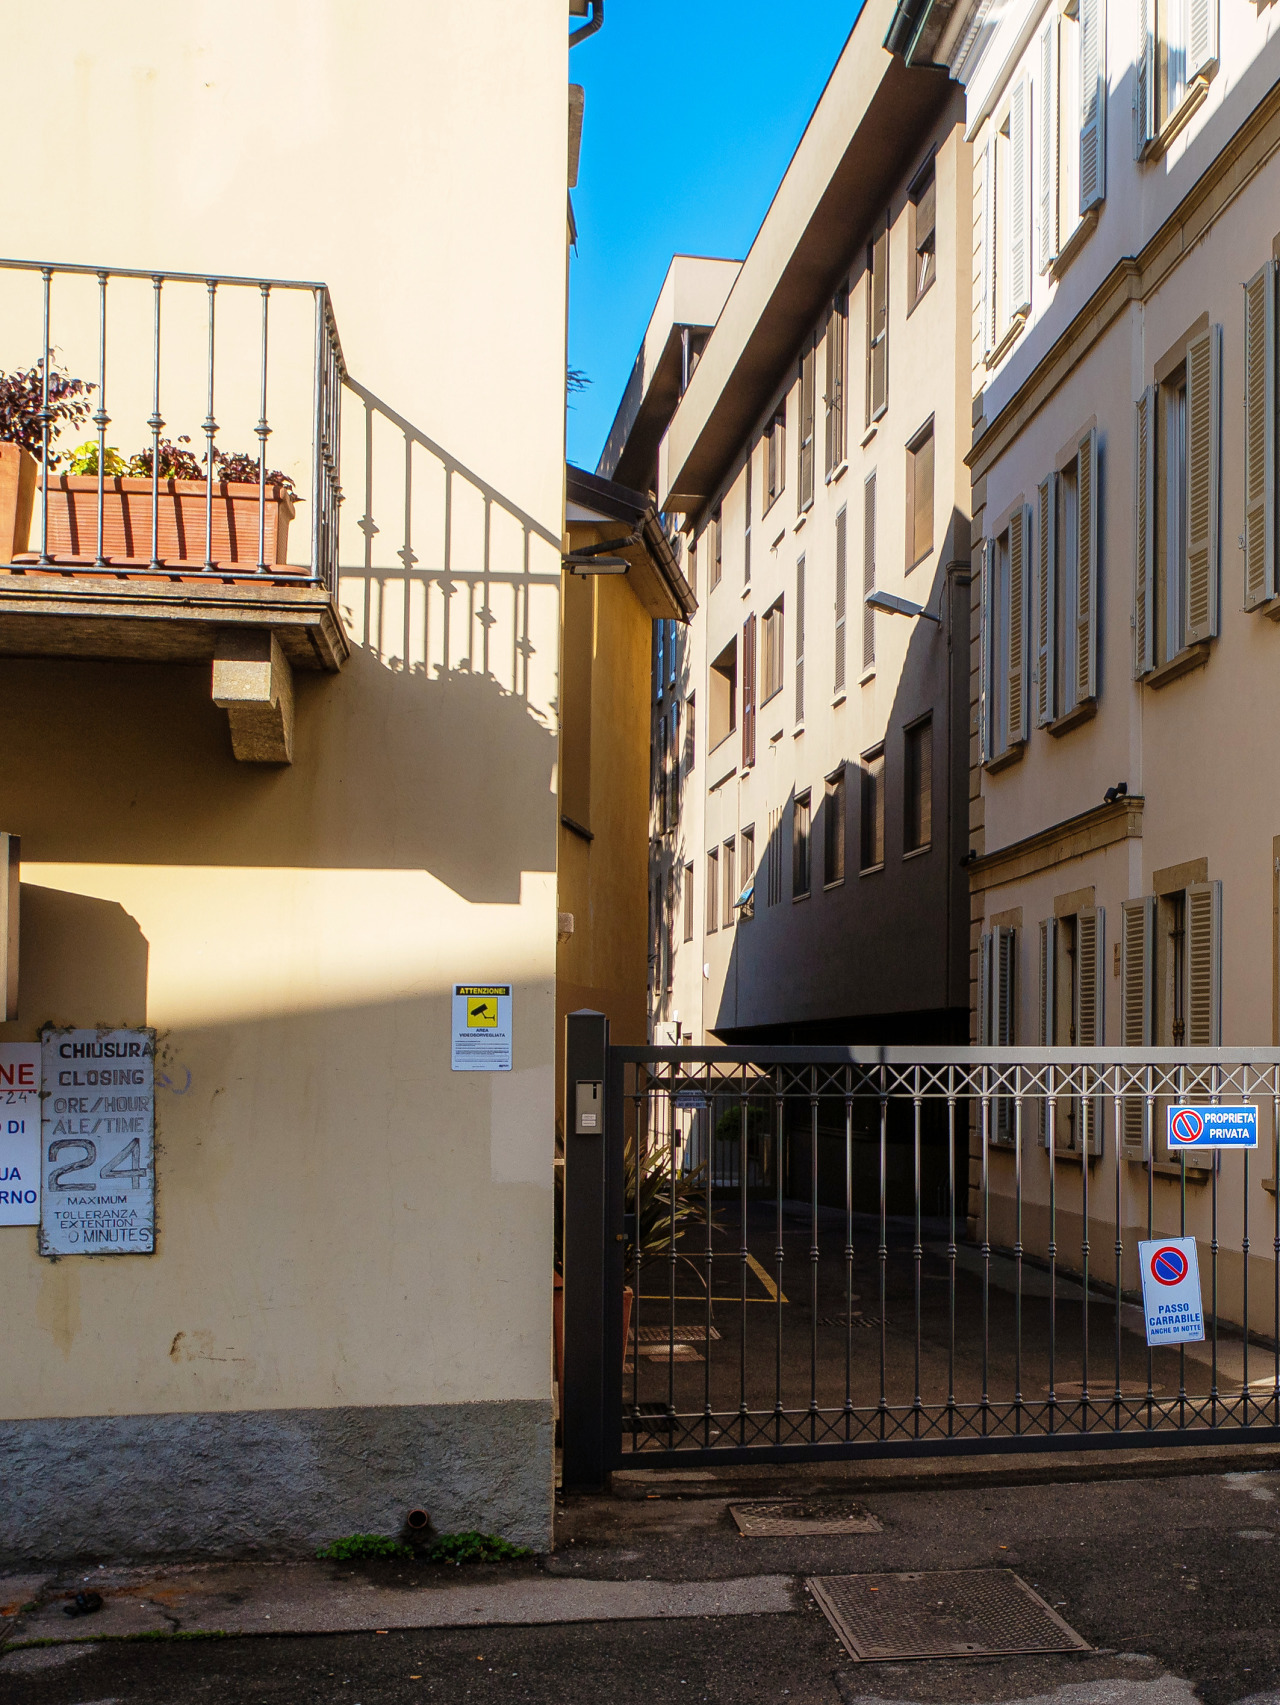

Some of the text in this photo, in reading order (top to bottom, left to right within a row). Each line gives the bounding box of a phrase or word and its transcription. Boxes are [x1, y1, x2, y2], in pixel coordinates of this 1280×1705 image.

[460, 987, 506, 995] ATTENZIONE!
[59, 1042, 153, 1058] CHIUSURA
[58, 1069, 144, 1086] CLOSING
[8, 1120, 25, 1134] DI
[1209, 1128, 1250, 1139] PRIVATA
[48, 1137, 147, 1192] 24
[67, 1195, 128, 1206] MAXIMUM
[54, 1209, 138, 1220] TOLLERANZA
[60, 1218, 134, 1230] EXTENTION
[83, 1227, 150, 1243] MINUTES
[1158, 1302, 1190, 1315] PASSO
[1149, 1312, 1201, 1327] CARRABILE
[1150, 1327, 1172, 1336] ANCHE
[1181, 1324, 1201, 1332] NOTTE
